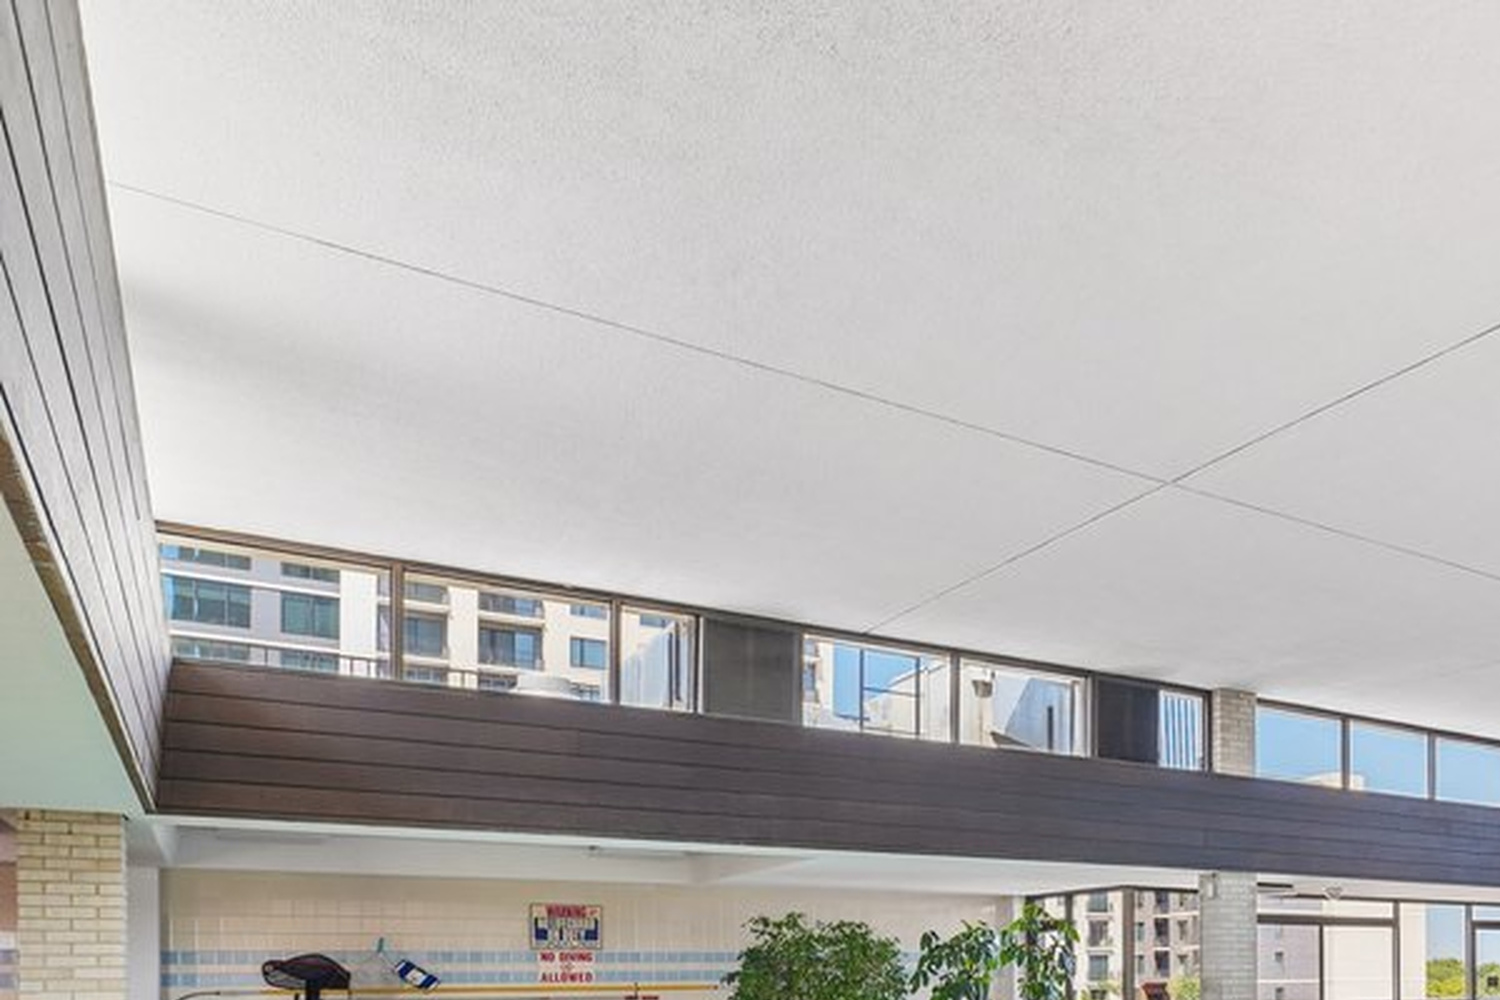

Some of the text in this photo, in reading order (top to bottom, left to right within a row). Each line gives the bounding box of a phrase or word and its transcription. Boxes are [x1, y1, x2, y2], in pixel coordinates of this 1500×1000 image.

[540, 952, 594, 962] NO DIVING
[540, 972, 594, 983] ALLOWED
